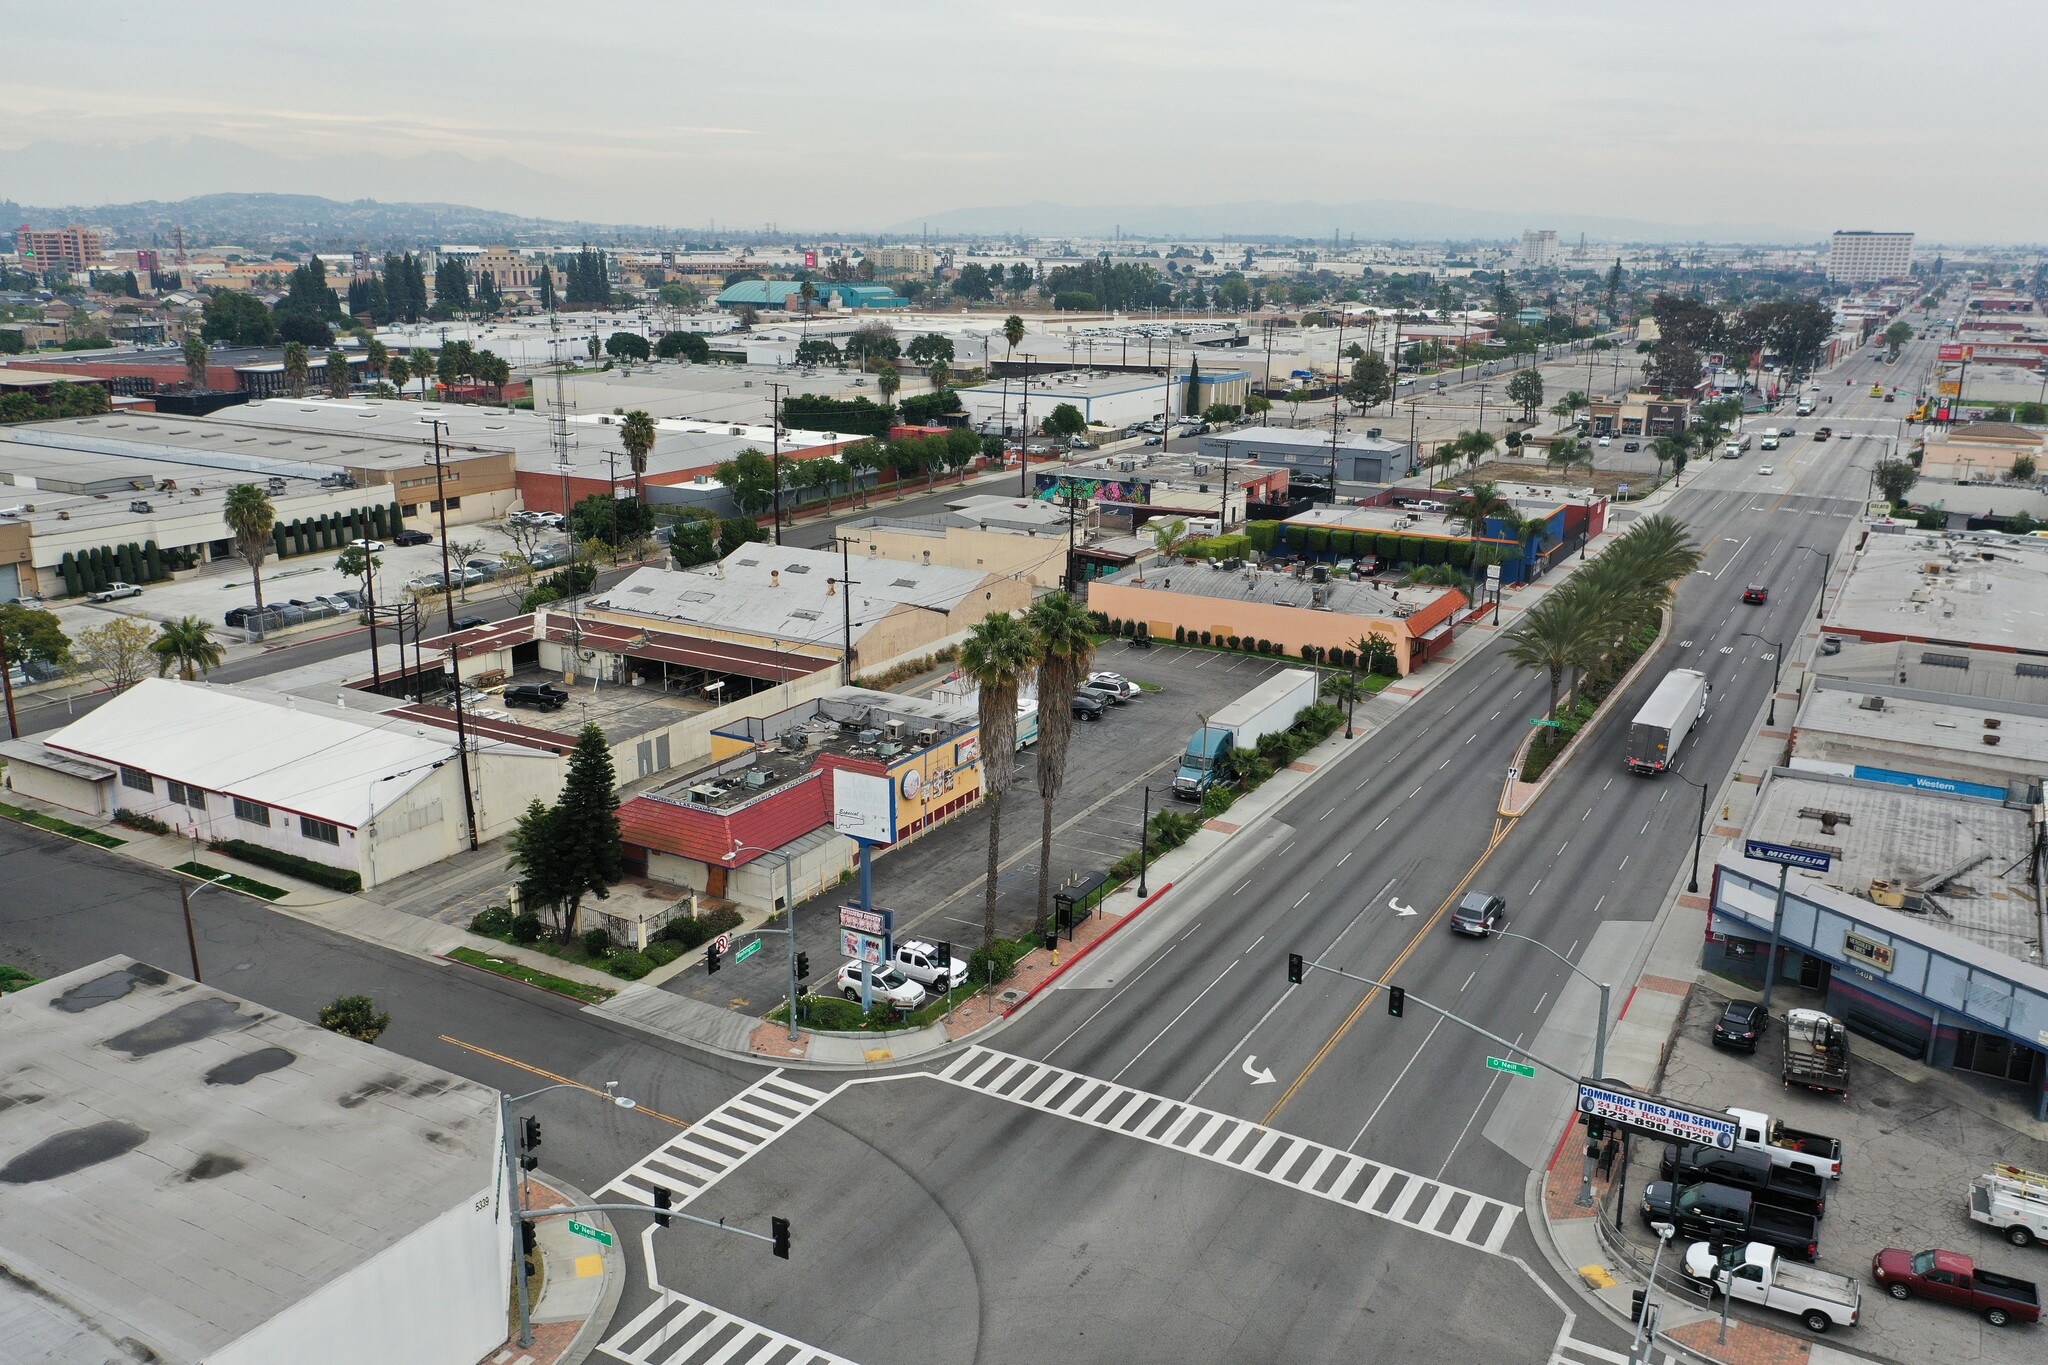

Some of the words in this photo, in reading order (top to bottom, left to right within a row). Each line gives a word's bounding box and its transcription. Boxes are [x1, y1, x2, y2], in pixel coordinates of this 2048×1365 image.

[1680, 640, 1693, 648] 40
[1720, 646, 1733, 654] 40
[1761, 653, 1774, 661] 40
[1916, 778, 1955, 791] Western
[1767, 850, 1826, 865] MICHELIN
[1853, 945, 1866, 954] TIRES
[1855, 969, 1873, 980] 5408
[1580, 1086, 1636, 1109] COMMERCE
[1638, 1101, 1667, 1118] TIRES
[1668, 1108, 1689, 1123] AND
[1691, 1115, 1735, 1135] SERVICE
[1597, 1100, 1610, 1110] 24
[1614, 1104, 1637, 1117] Hrs.
[1641, 1111, 1669, 1125] Road
[1672, 1120, 1715, 1137] Service
[1597, 1107, 1713, 1144] 323-890-0120
[475, 1196, 489, 1211] 5339
